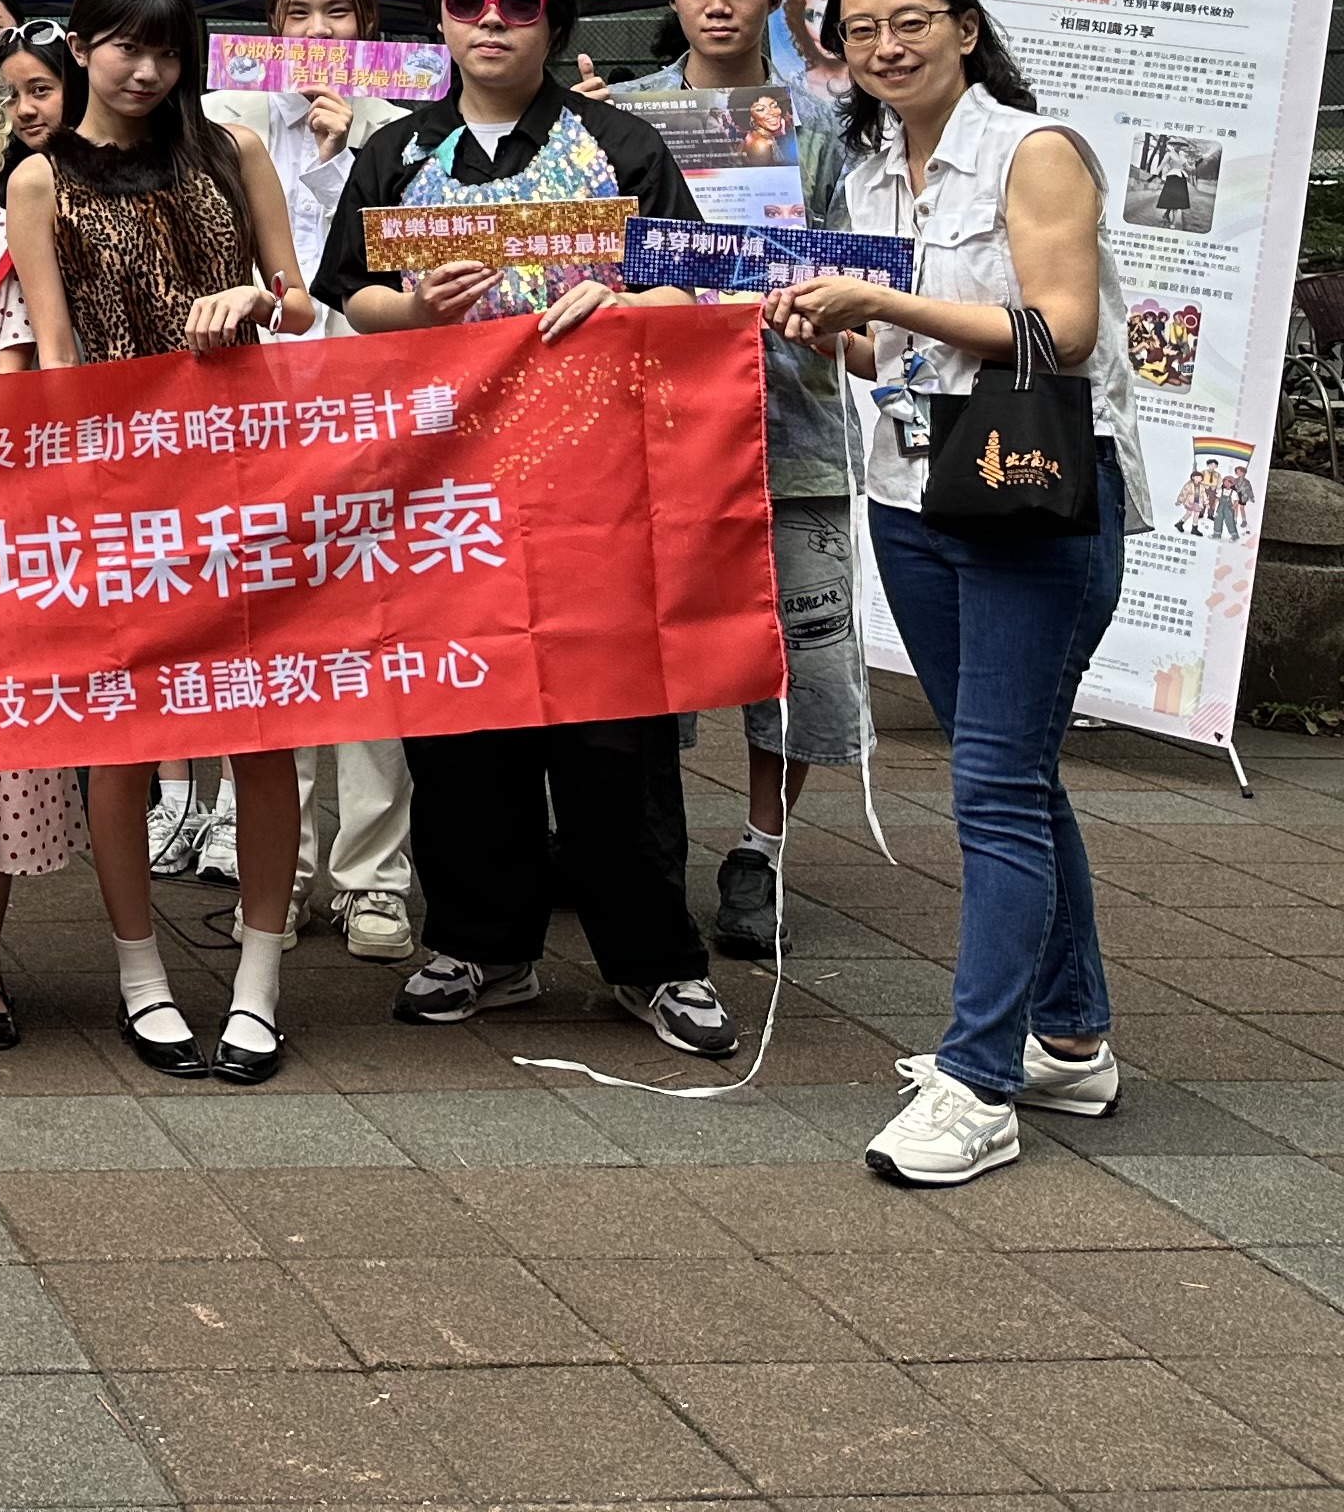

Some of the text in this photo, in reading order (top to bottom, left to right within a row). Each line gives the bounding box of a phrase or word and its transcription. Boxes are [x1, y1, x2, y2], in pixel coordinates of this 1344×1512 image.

[1060, 16, 1155, 38] 相關知識分享
[292, 67, 433, 89] 活出自我最性感
[381, 214, 497, 239] 歡樂迪斯可
[503, 231, 621, 257] 全場我最扯
[642, 229, 765, 258] 身穿喇叭褲
[159, 639, 491, 718] 通識教育中心
